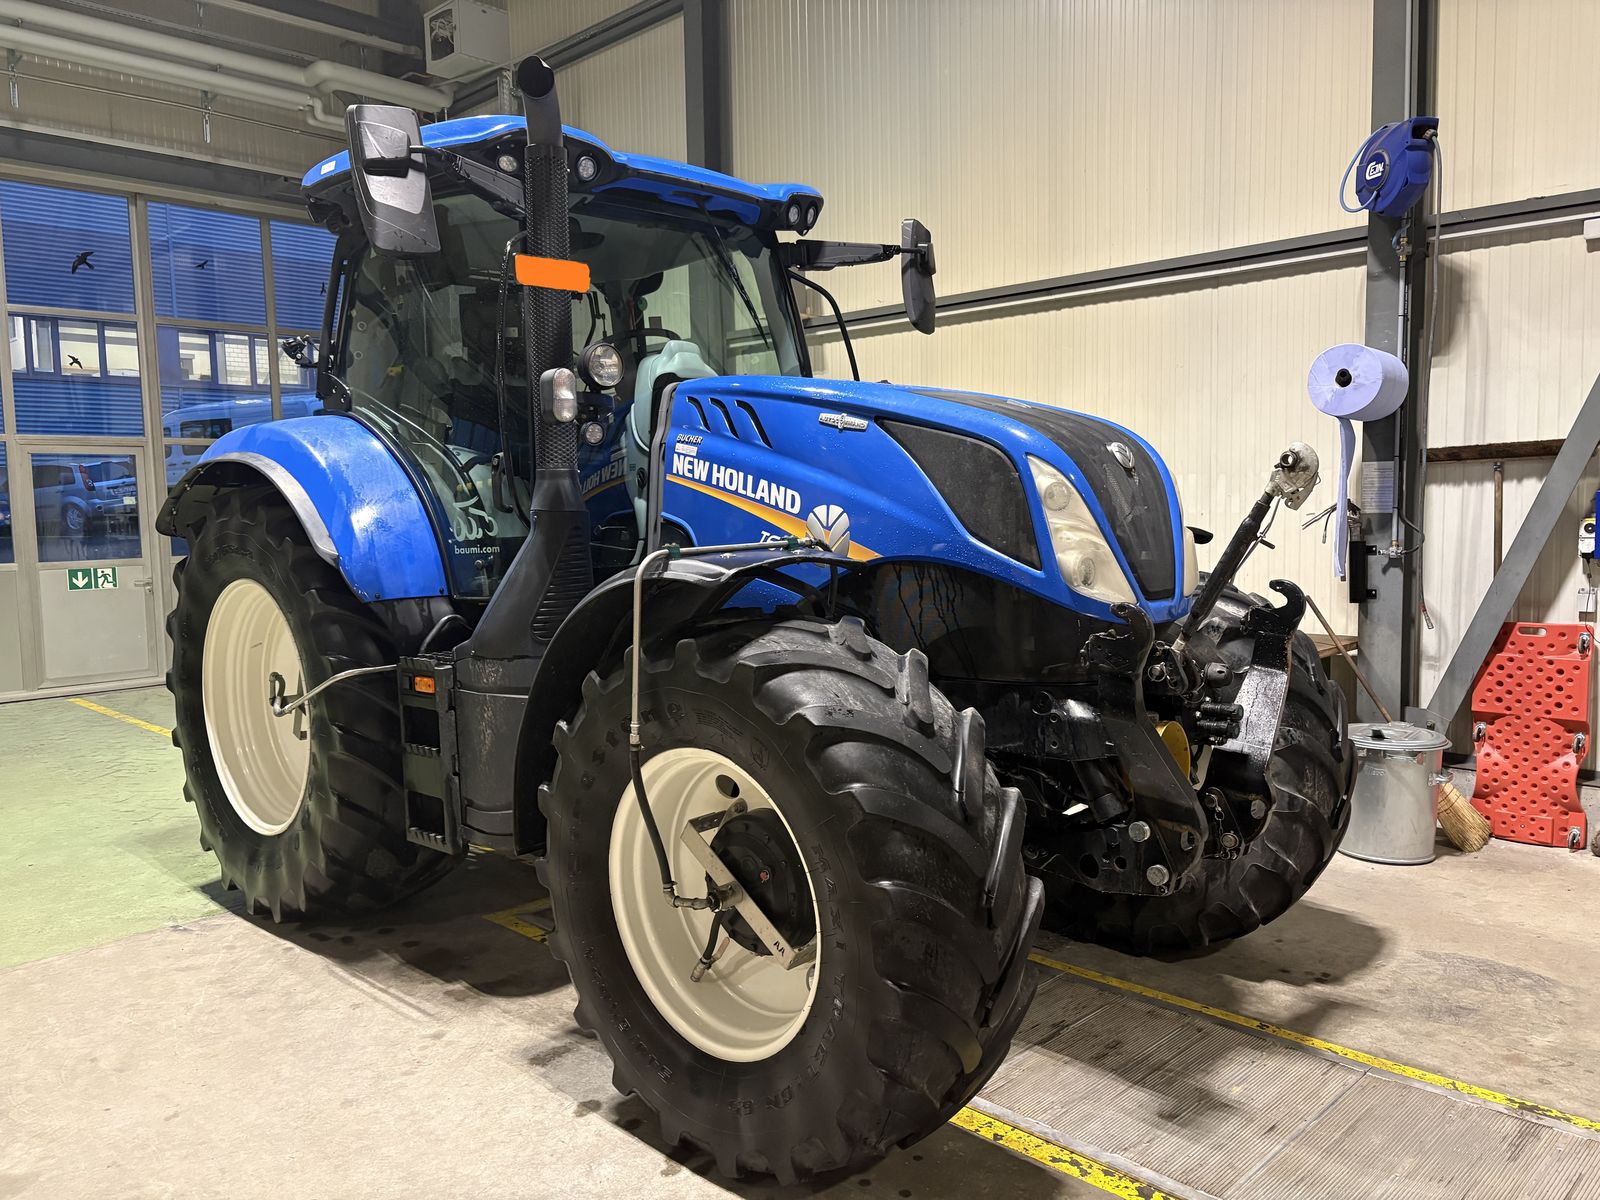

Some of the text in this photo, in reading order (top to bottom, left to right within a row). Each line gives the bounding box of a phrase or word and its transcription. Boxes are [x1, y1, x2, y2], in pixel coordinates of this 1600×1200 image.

[676, 433, 704, 445] BUCHER
[672, 453, 801, 515] NEW HOLLAND
[454, 544, 500, 555] baumi.com
